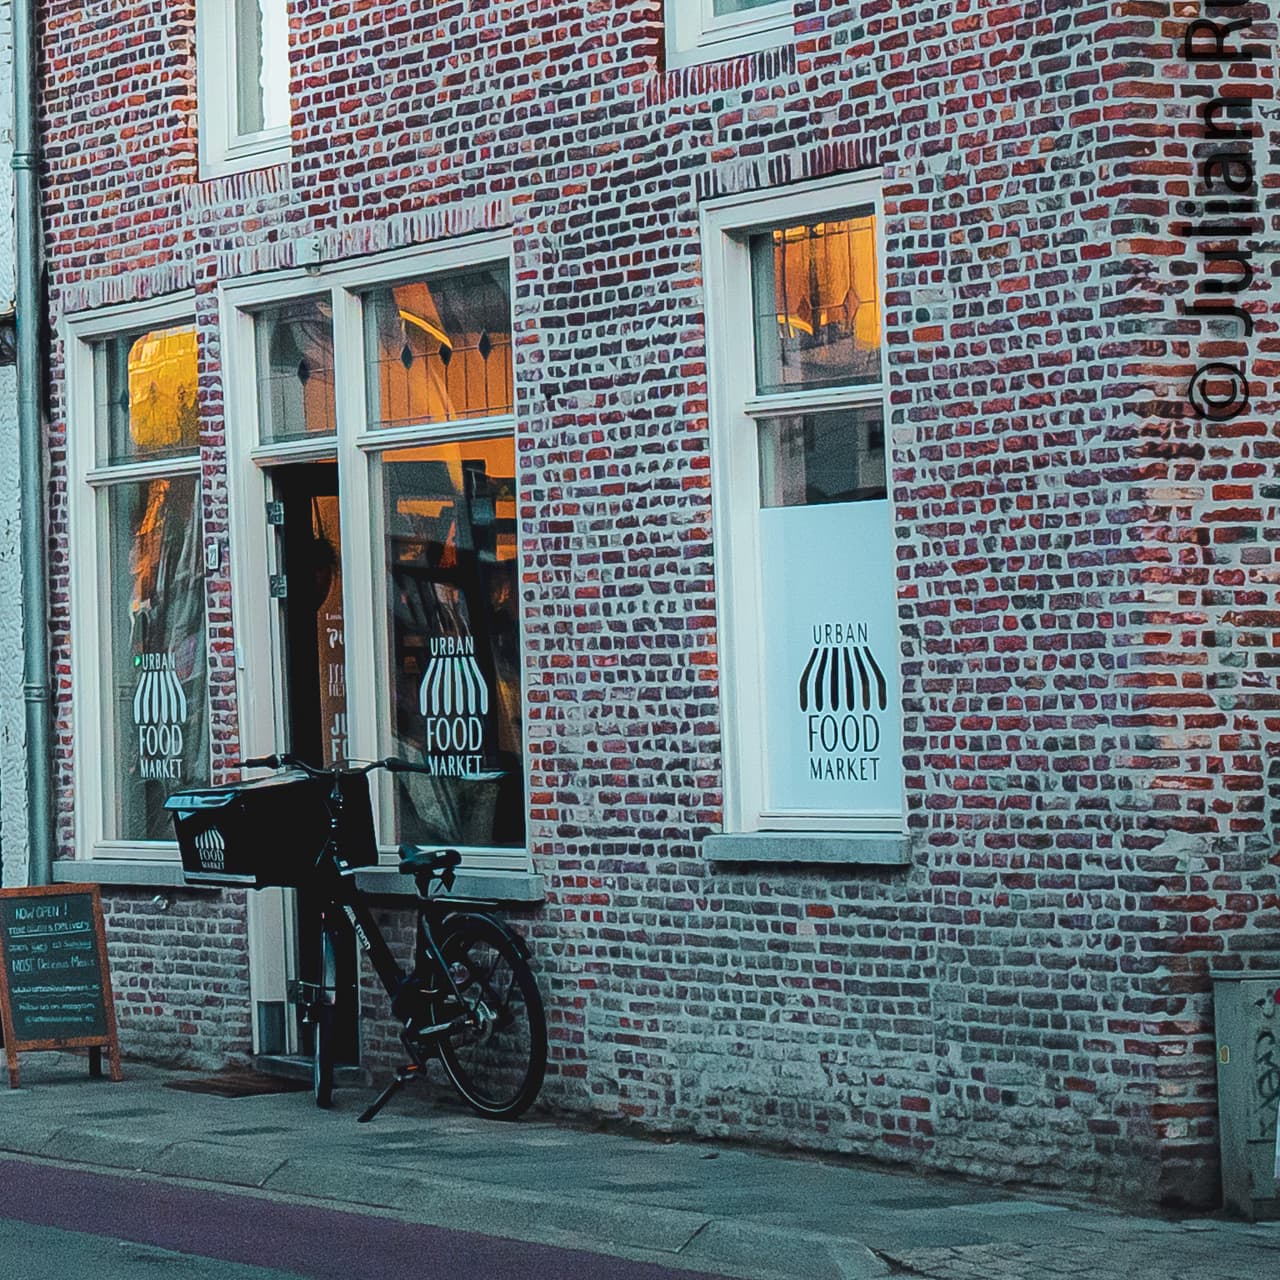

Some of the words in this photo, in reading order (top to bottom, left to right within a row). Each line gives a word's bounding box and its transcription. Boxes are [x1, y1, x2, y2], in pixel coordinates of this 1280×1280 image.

[813, 623, 868, 645] URBAN
[430, 636, 474, 657] URBAN
[142, 652, 176, 671] URBAN
[139, 724, 183, 756] FOOD
[426, 717, 483, 752] FOOD
[808, 714, 880, 753] FOOD
[140, 759, 183, 779] MARKET
[428, 755, 483, 777] MARKET
[810, 757, 880, 781] MARKET
[12, 958, 34, 973] MOST
